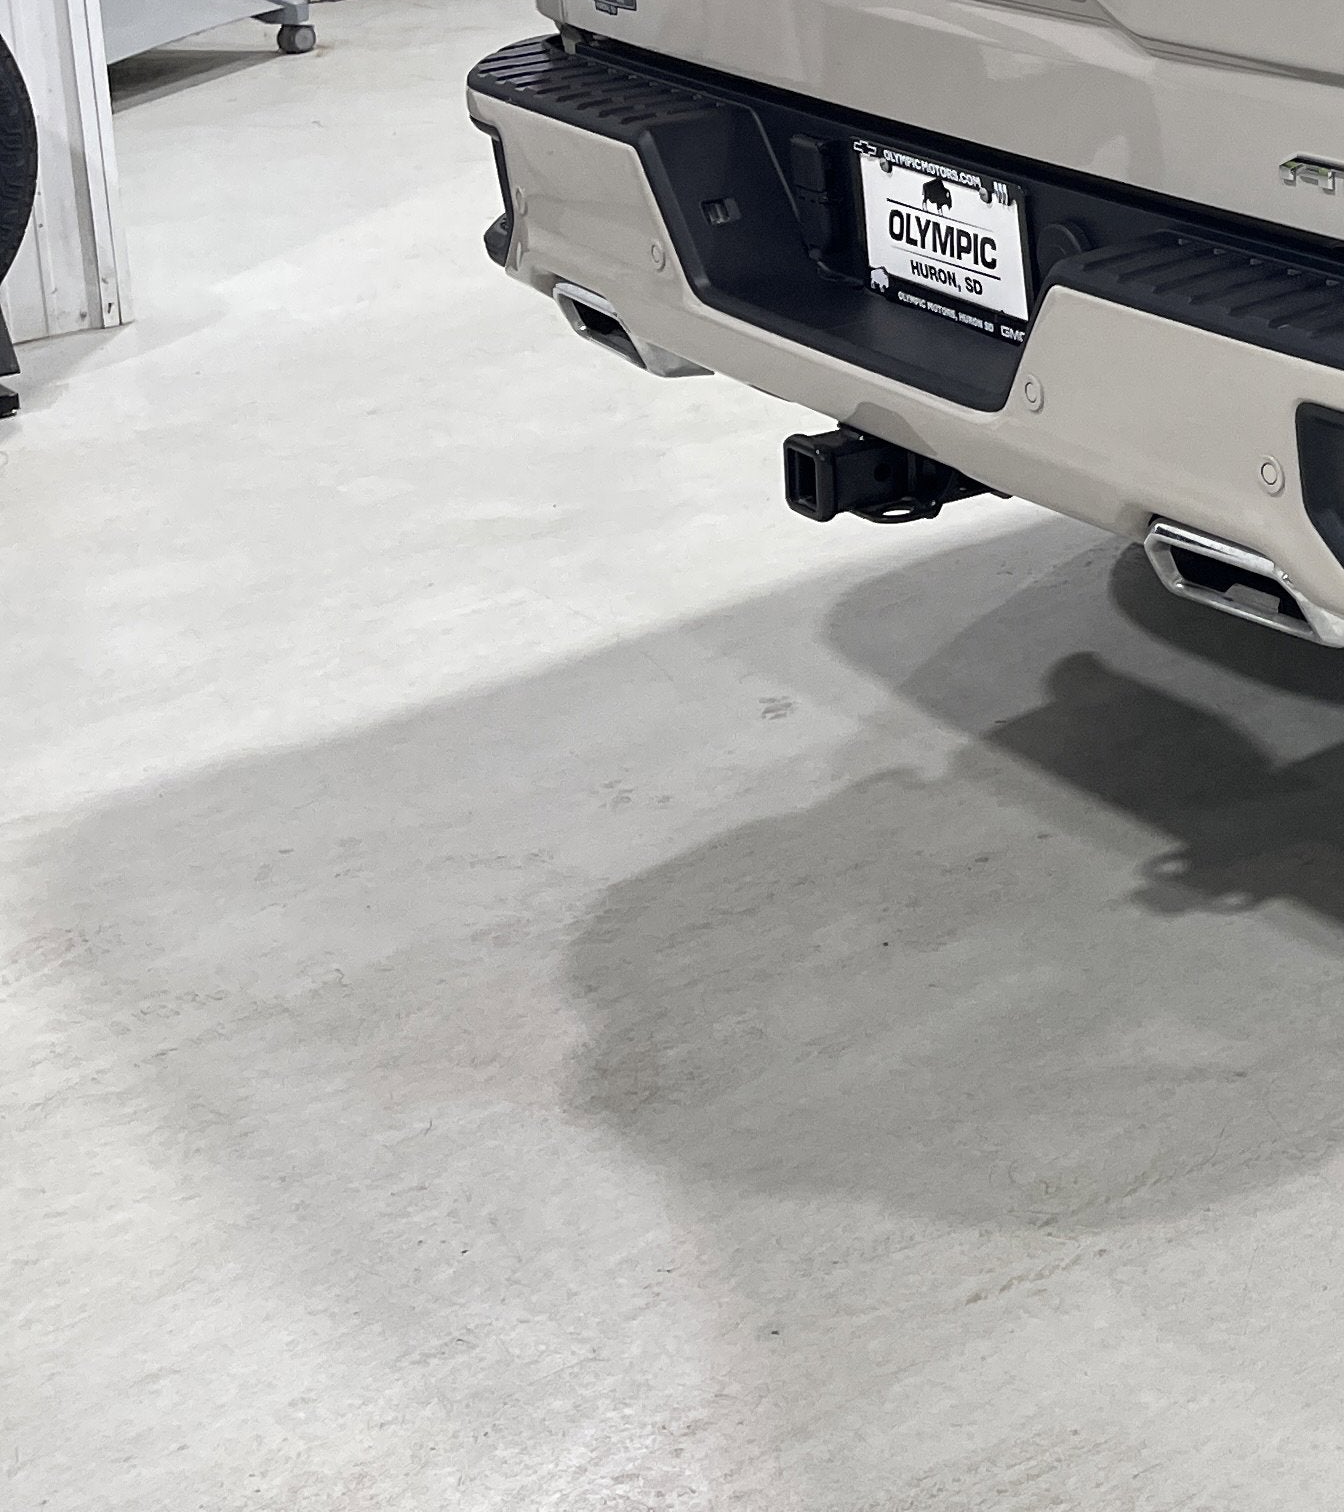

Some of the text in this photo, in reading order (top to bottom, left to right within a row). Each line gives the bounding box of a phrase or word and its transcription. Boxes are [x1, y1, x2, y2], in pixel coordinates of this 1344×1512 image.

[889, 209, 998, 270] OLYMPIC
[910, 259, 983, 296] HURON, SD
[898, 291, 926, 309] OLYMPIC
[1000, 325, 1026, 342] GMC
